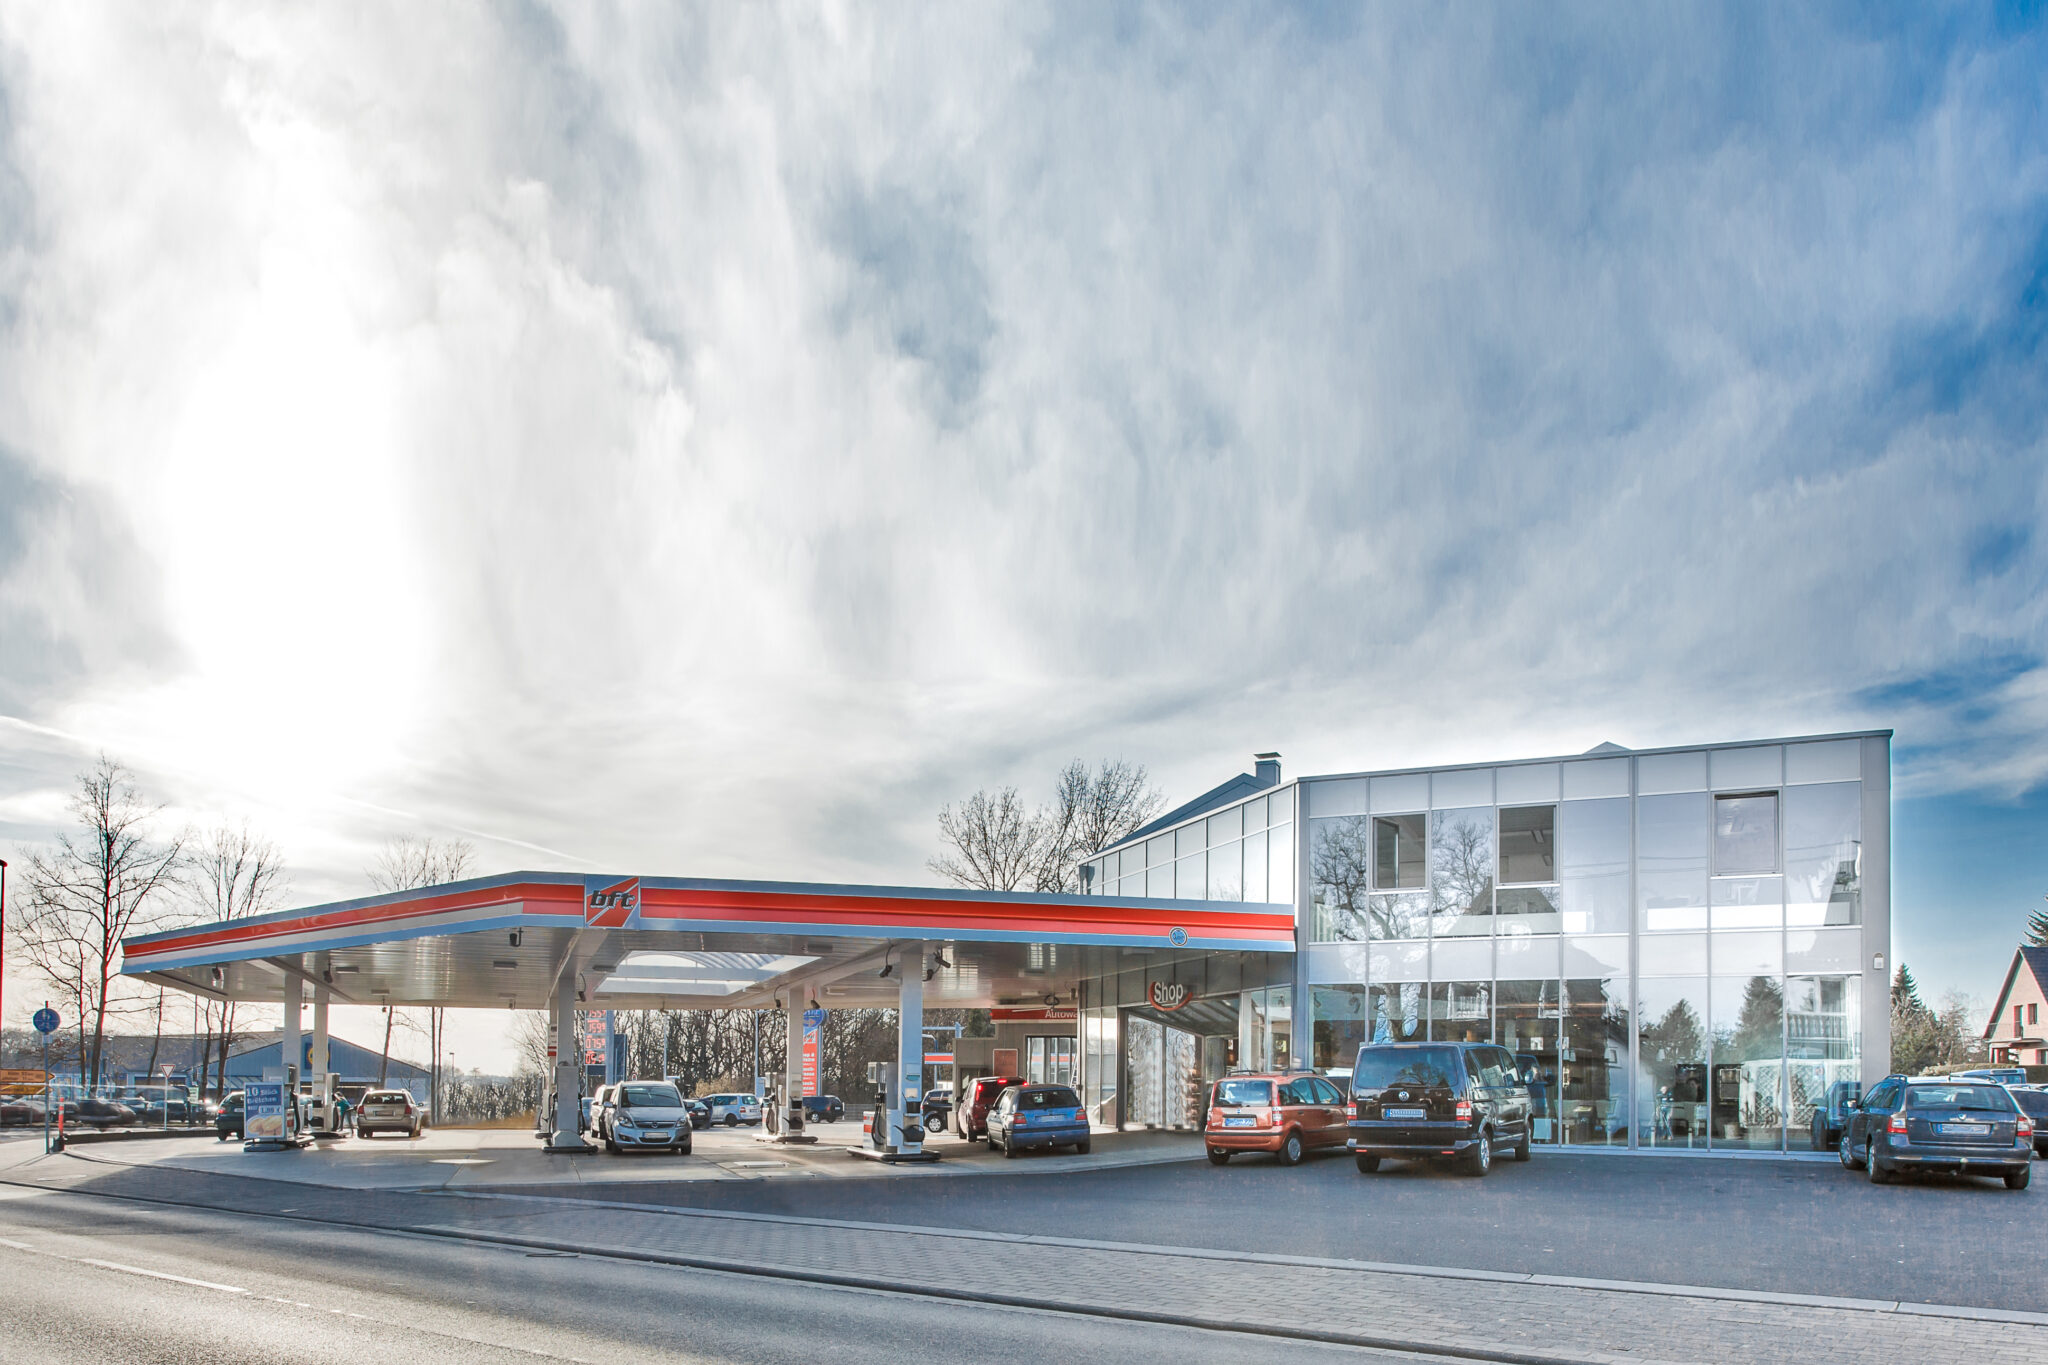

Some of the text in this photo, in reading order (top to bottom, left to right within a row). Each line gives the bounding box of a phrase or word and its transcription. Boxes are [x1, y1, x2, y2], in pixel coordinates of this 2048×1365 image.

[590, 890, 635, 909] bft
[1154, 981, 1184, 1005] Shop
[247, 1087, 260, 1097] 10
